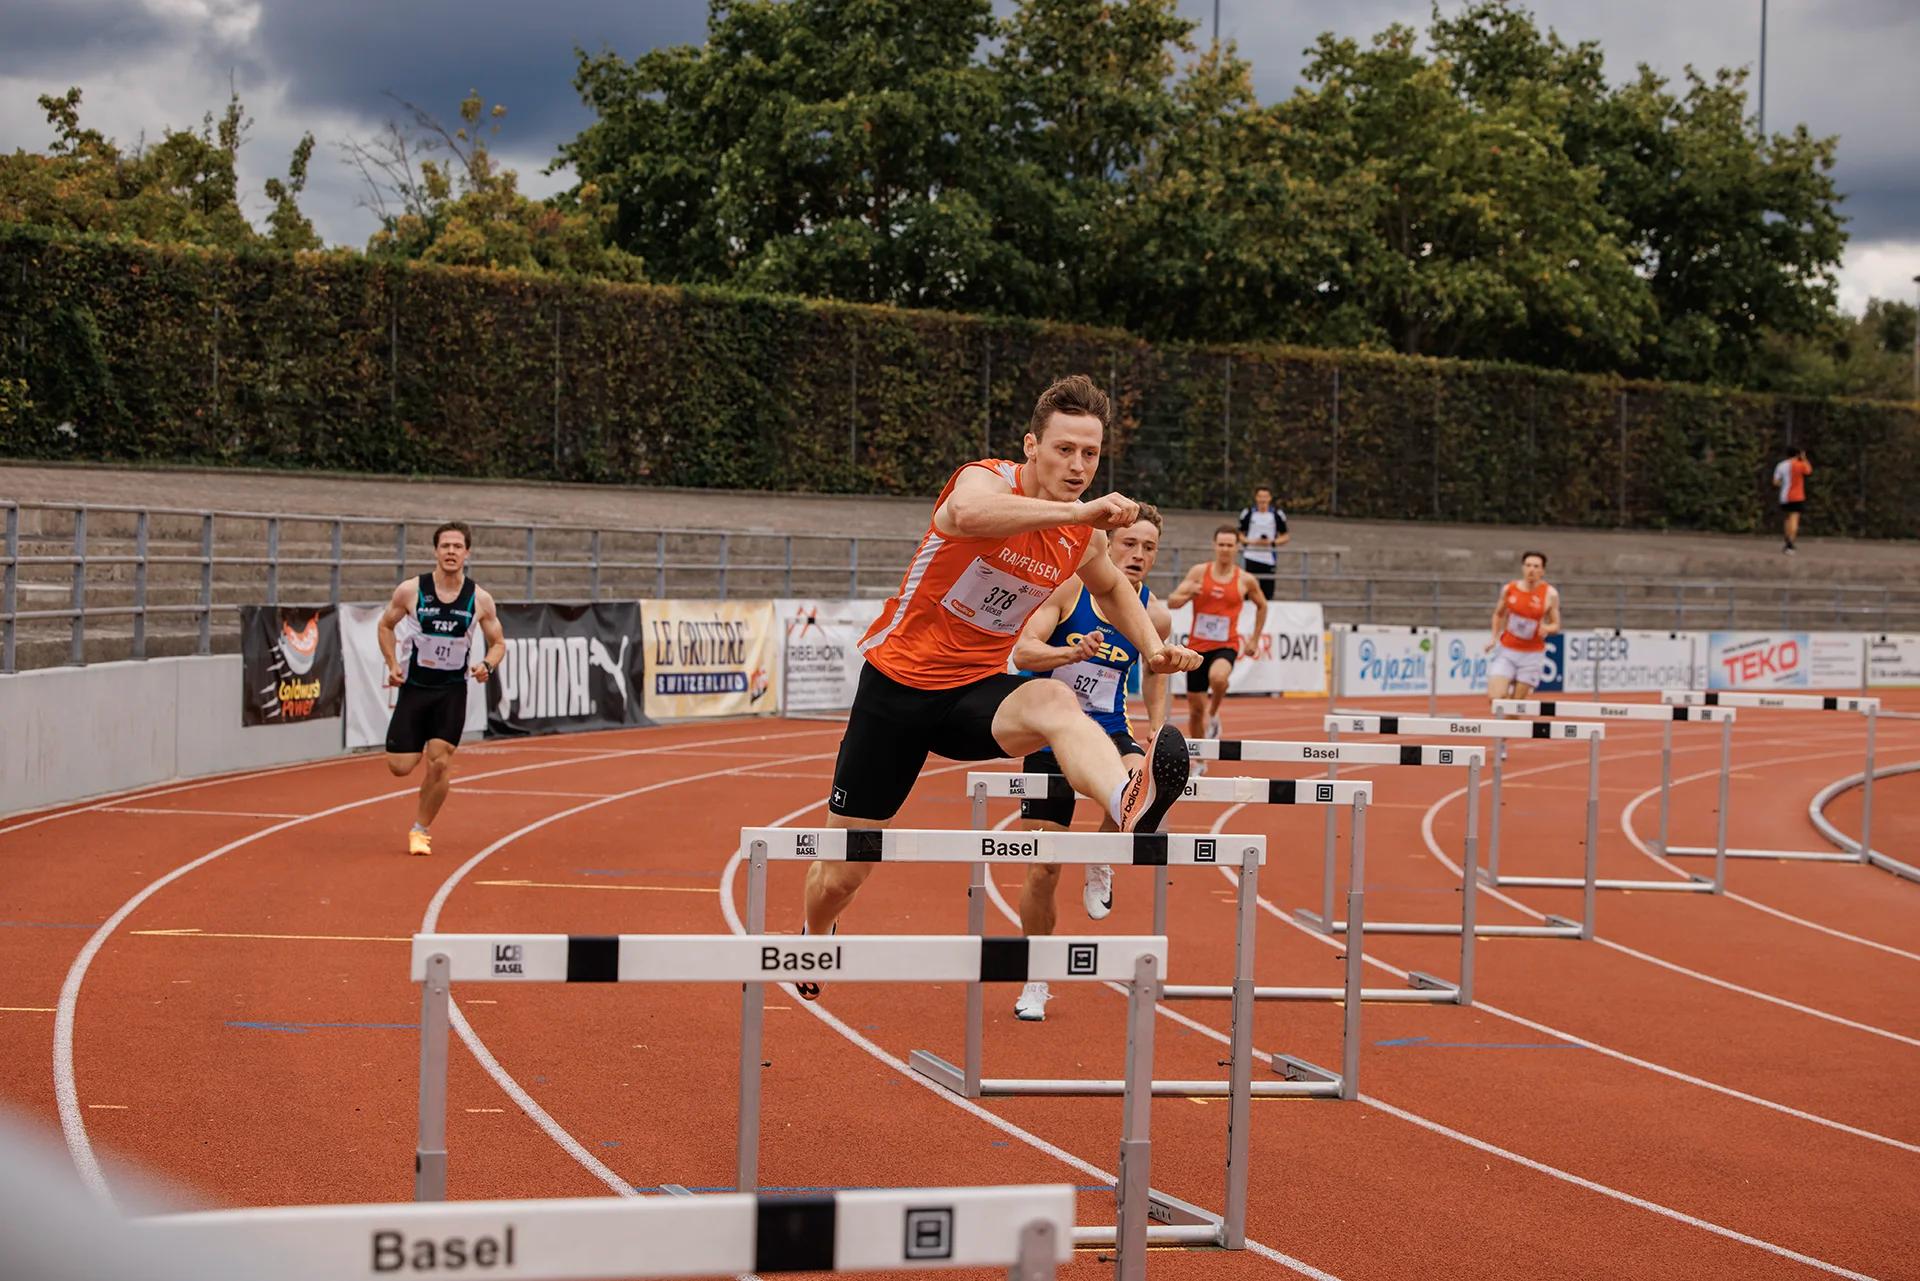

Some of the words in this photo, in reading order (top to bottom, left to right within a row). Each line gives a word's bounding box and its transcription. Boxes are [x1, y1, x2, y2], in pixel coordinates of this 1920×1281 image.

[998, 547, 1061, 581] RAIFFEISEN
[983, 586, 1018, 610] 378
[432, 620, 459, 633] TSV
[653, 620, 674, 666] LE
[678, 612, 746, 666] GRUYÈRE
[1280, 633, 1317, 661] DAY!
[1570, 637, 1628, 661] SIEBER
[435, 645, 451, 658] 471
[1722, 640, 1799, 685] TEKO
[498, 636, 590, 720] PUMA
[658, 674, 745, 693] SWITZERLAND
[1073, 674, 1098, 694] 527
[1450, 722, 1482, 733] Basel
[1303, 746, 1339, 759] Basel
[1124, 769, 1143, 813] balance
[796, 847, 816, 855] BASEL
[981, 838, 1038, 856] Basel
[494, 963, 523, 974] BASEL
[761, 945, 842, 971] Basel
[372, 1223, 514, 1273] Basel
